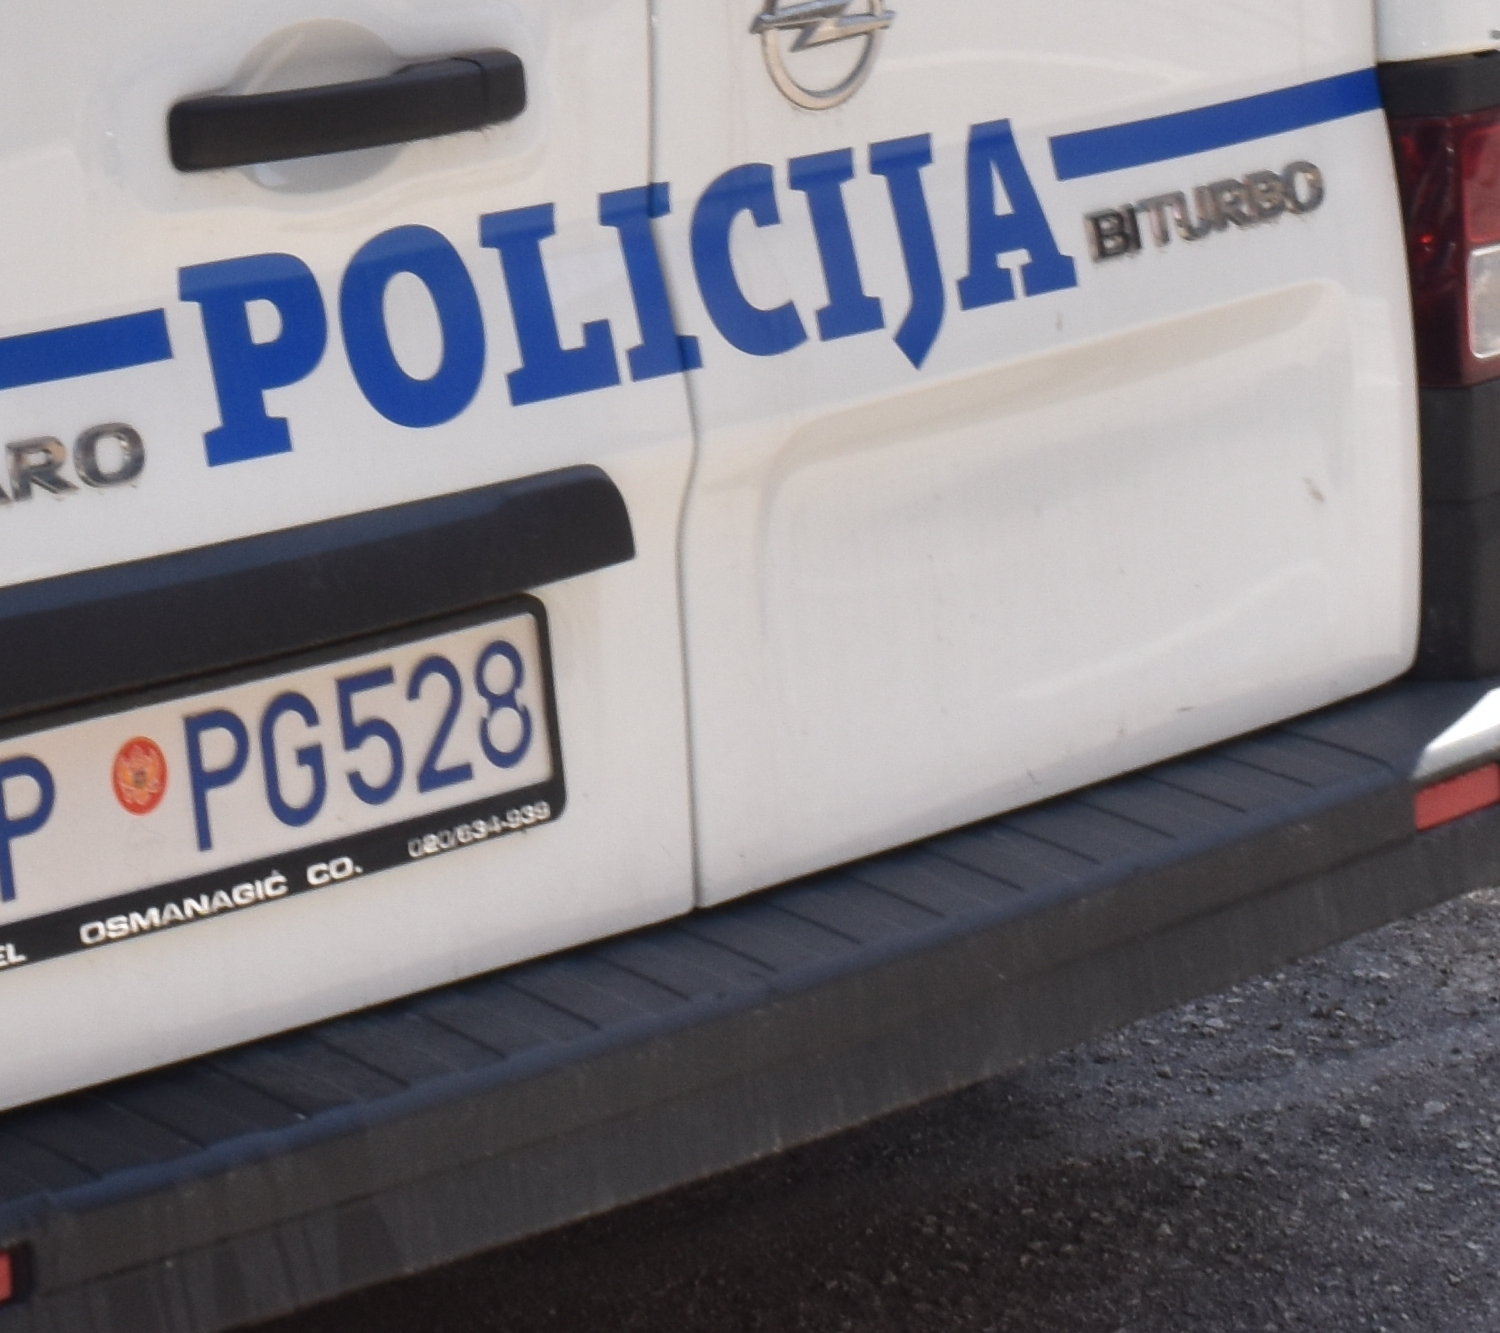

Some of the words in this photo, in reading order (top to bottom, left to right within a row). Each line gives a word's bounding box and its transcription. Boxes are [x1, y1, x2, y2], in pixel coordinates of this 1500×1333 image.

[1083, 160, 1326, 263] BITURBO
[177, 118, 1079, 467] POLICIJA
[183, 639, 534, 852] PG528
[306, 856, 364, 886] CO.
